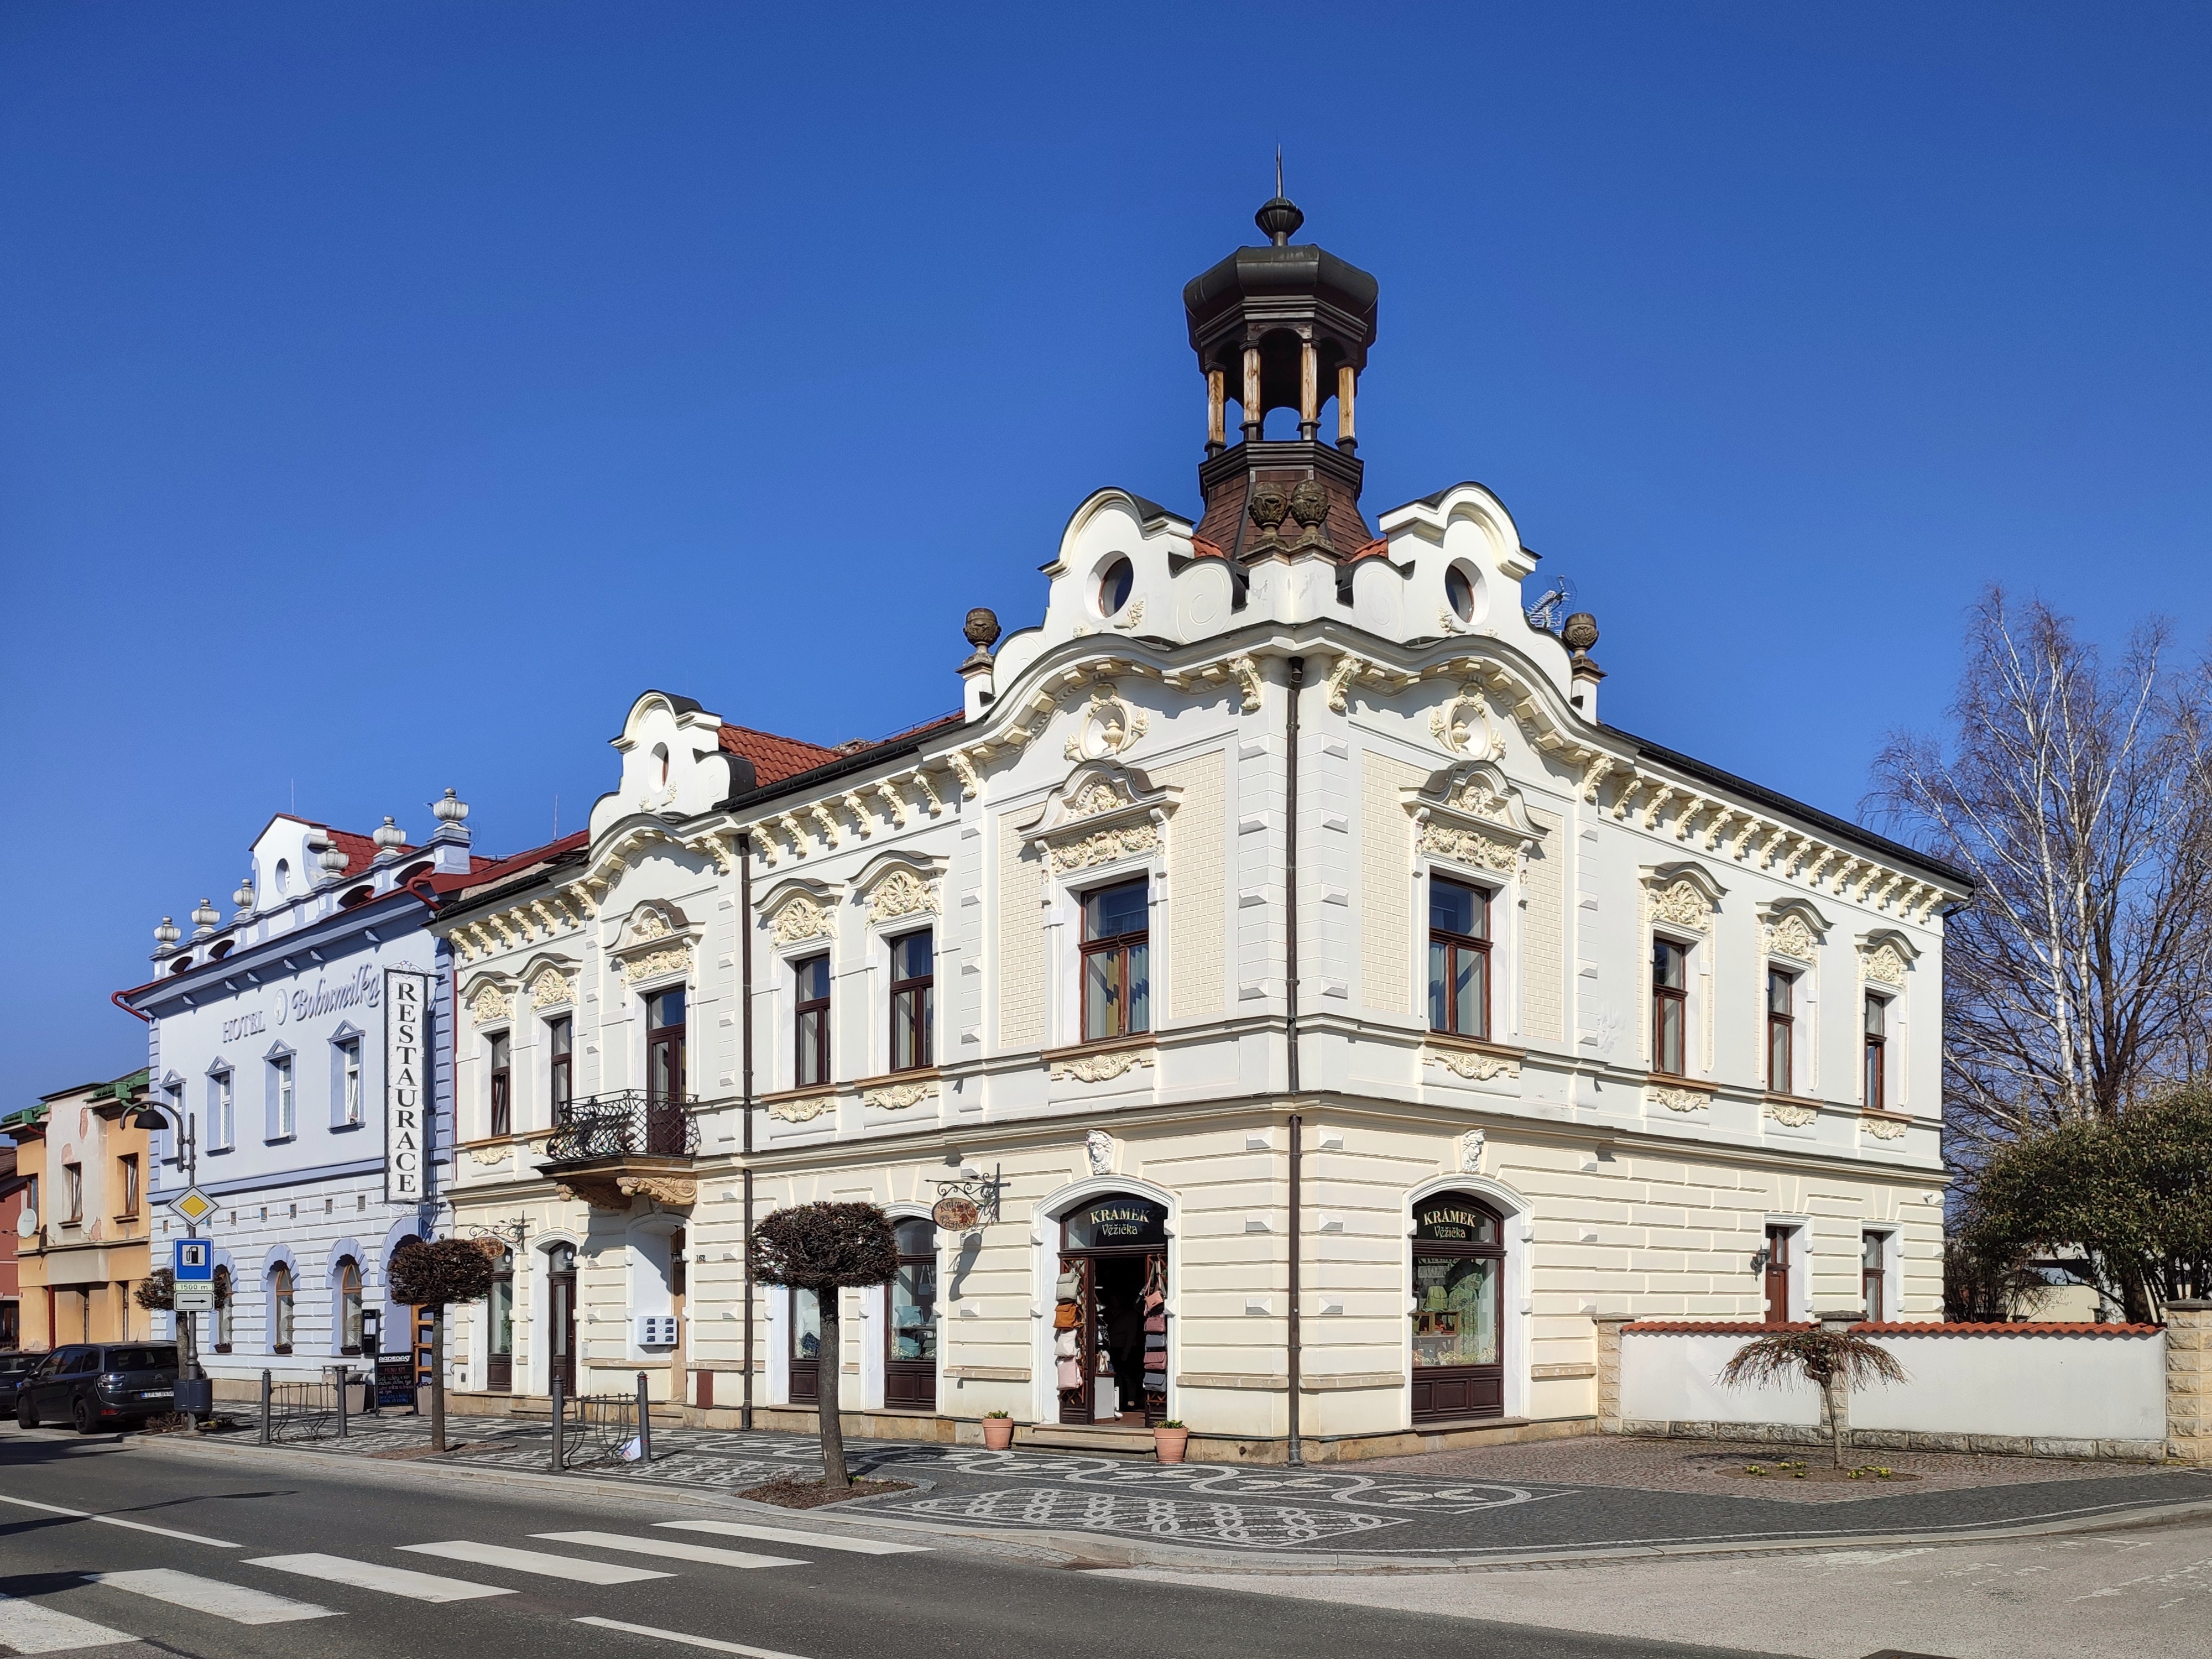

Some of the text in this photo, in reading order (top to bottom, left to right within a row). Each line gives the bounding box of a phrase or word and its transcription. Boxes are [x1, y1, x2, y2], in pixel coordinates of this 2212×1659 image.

[222, 1010, 266, 1044] HOTEL
[395, 982, 419, 1192] RESTAURACE
[1090, 1205, 1150, 1225] KRÁMEK
[1423, 1207, 1477, 1228] KRÁMEK
[1102, 1223, 1138, 1237] Věžička
[1434, 1225, 1466, 1239] Věžička
